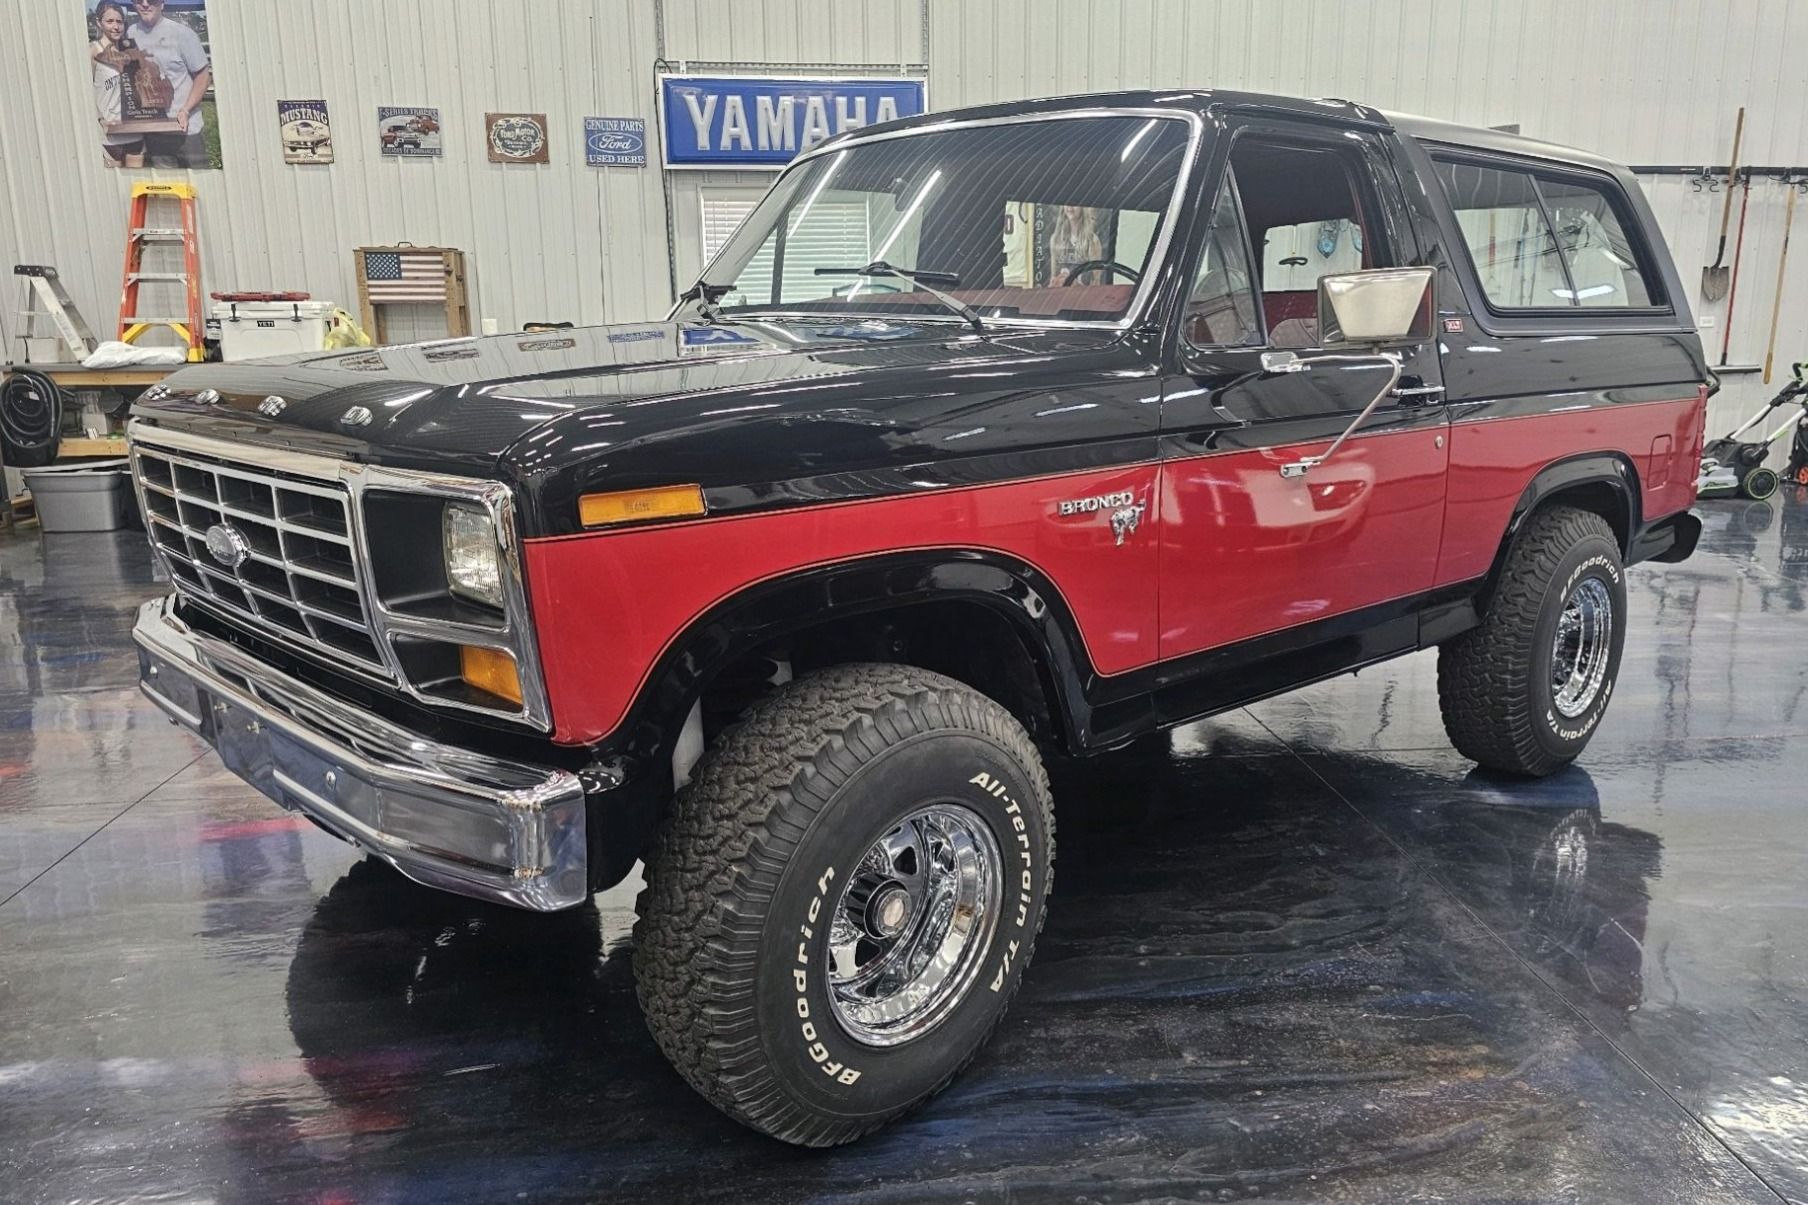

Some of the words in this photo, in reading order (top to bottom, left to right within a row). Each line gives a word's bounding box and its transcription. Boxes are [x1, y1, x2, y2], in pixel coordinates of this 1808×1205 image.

[280, 108, 328, 126] MUSTANG
[585, 119, 619, 131] GENUINE
[619, 120, 643, 132] PARTS
[682, 94, 898, 151] YAMAHA
[589, 155, 615, 163] USED
[617, 155, 644, 164] HERE
[599, 134, 631, 149] Ford
[1058, 492, 1134, 516] BRONCO
[1560, 554, 1619, 603] BFGoodrich
[969, 771, 1031, 927] All-Terrain
[793, 866, 861, 1086] BFGoodrich
[989, 940, 1020, 993] T/A
